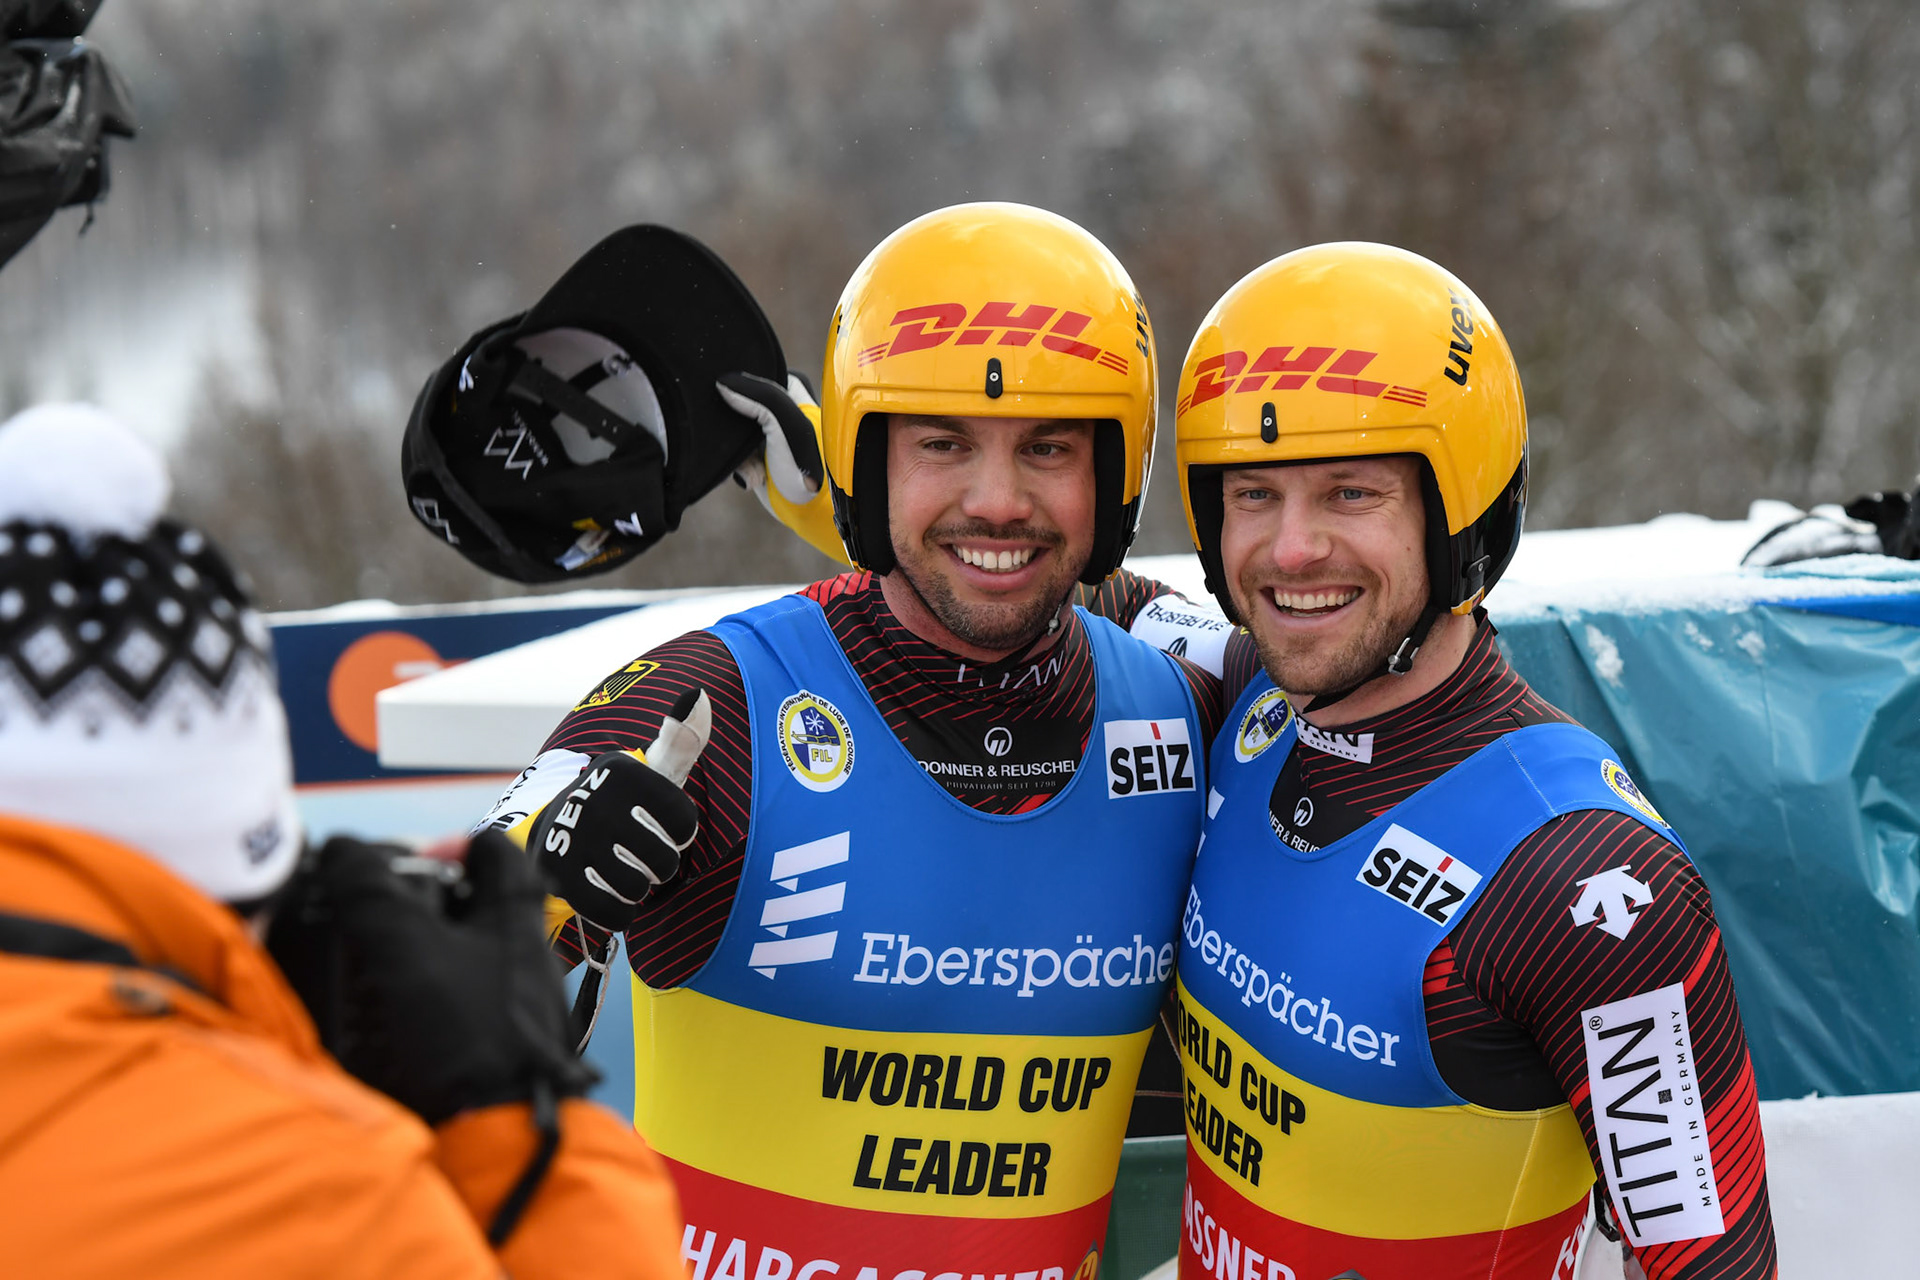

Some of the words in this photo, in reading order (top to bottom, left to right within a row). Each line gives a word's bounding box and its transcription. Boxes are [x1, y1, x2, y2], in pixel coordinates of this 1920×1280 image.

[888, 302, 1103, 361] DHL
[1190, 346, 1390, 408] DHL
[818, 699, 828, 709] DE
[829, 706, 846, 726] LUGE
[811, 748, 833, 762] FIL
[843, 727, 851, 739] DE
[843, 740, 854, 775] COURSE
[918, 761, 984, 777] DONNER
[987, 765, 998, 777] &
[1001, 760, 1077, 777] REUSCHEL
[545, 768, 611, 857] SEIZ
[1182, 884, 1400, 1067] Eberspächer
[821, 1046, 1005, 1112] WORLD
[1018, 1057, 1112, 1113] CUP
[1178, 999, 1232, 1089] ORLD
[1240, 1062, 1306, 1136] CUP
[1671, 1010, 1694, 1106] GERMANY
[1689, 1120, 1700, 1140] IN
[852, 1134, 1051, 1197] LEADER
[1694, 1153, 1712, 1207] MADE
